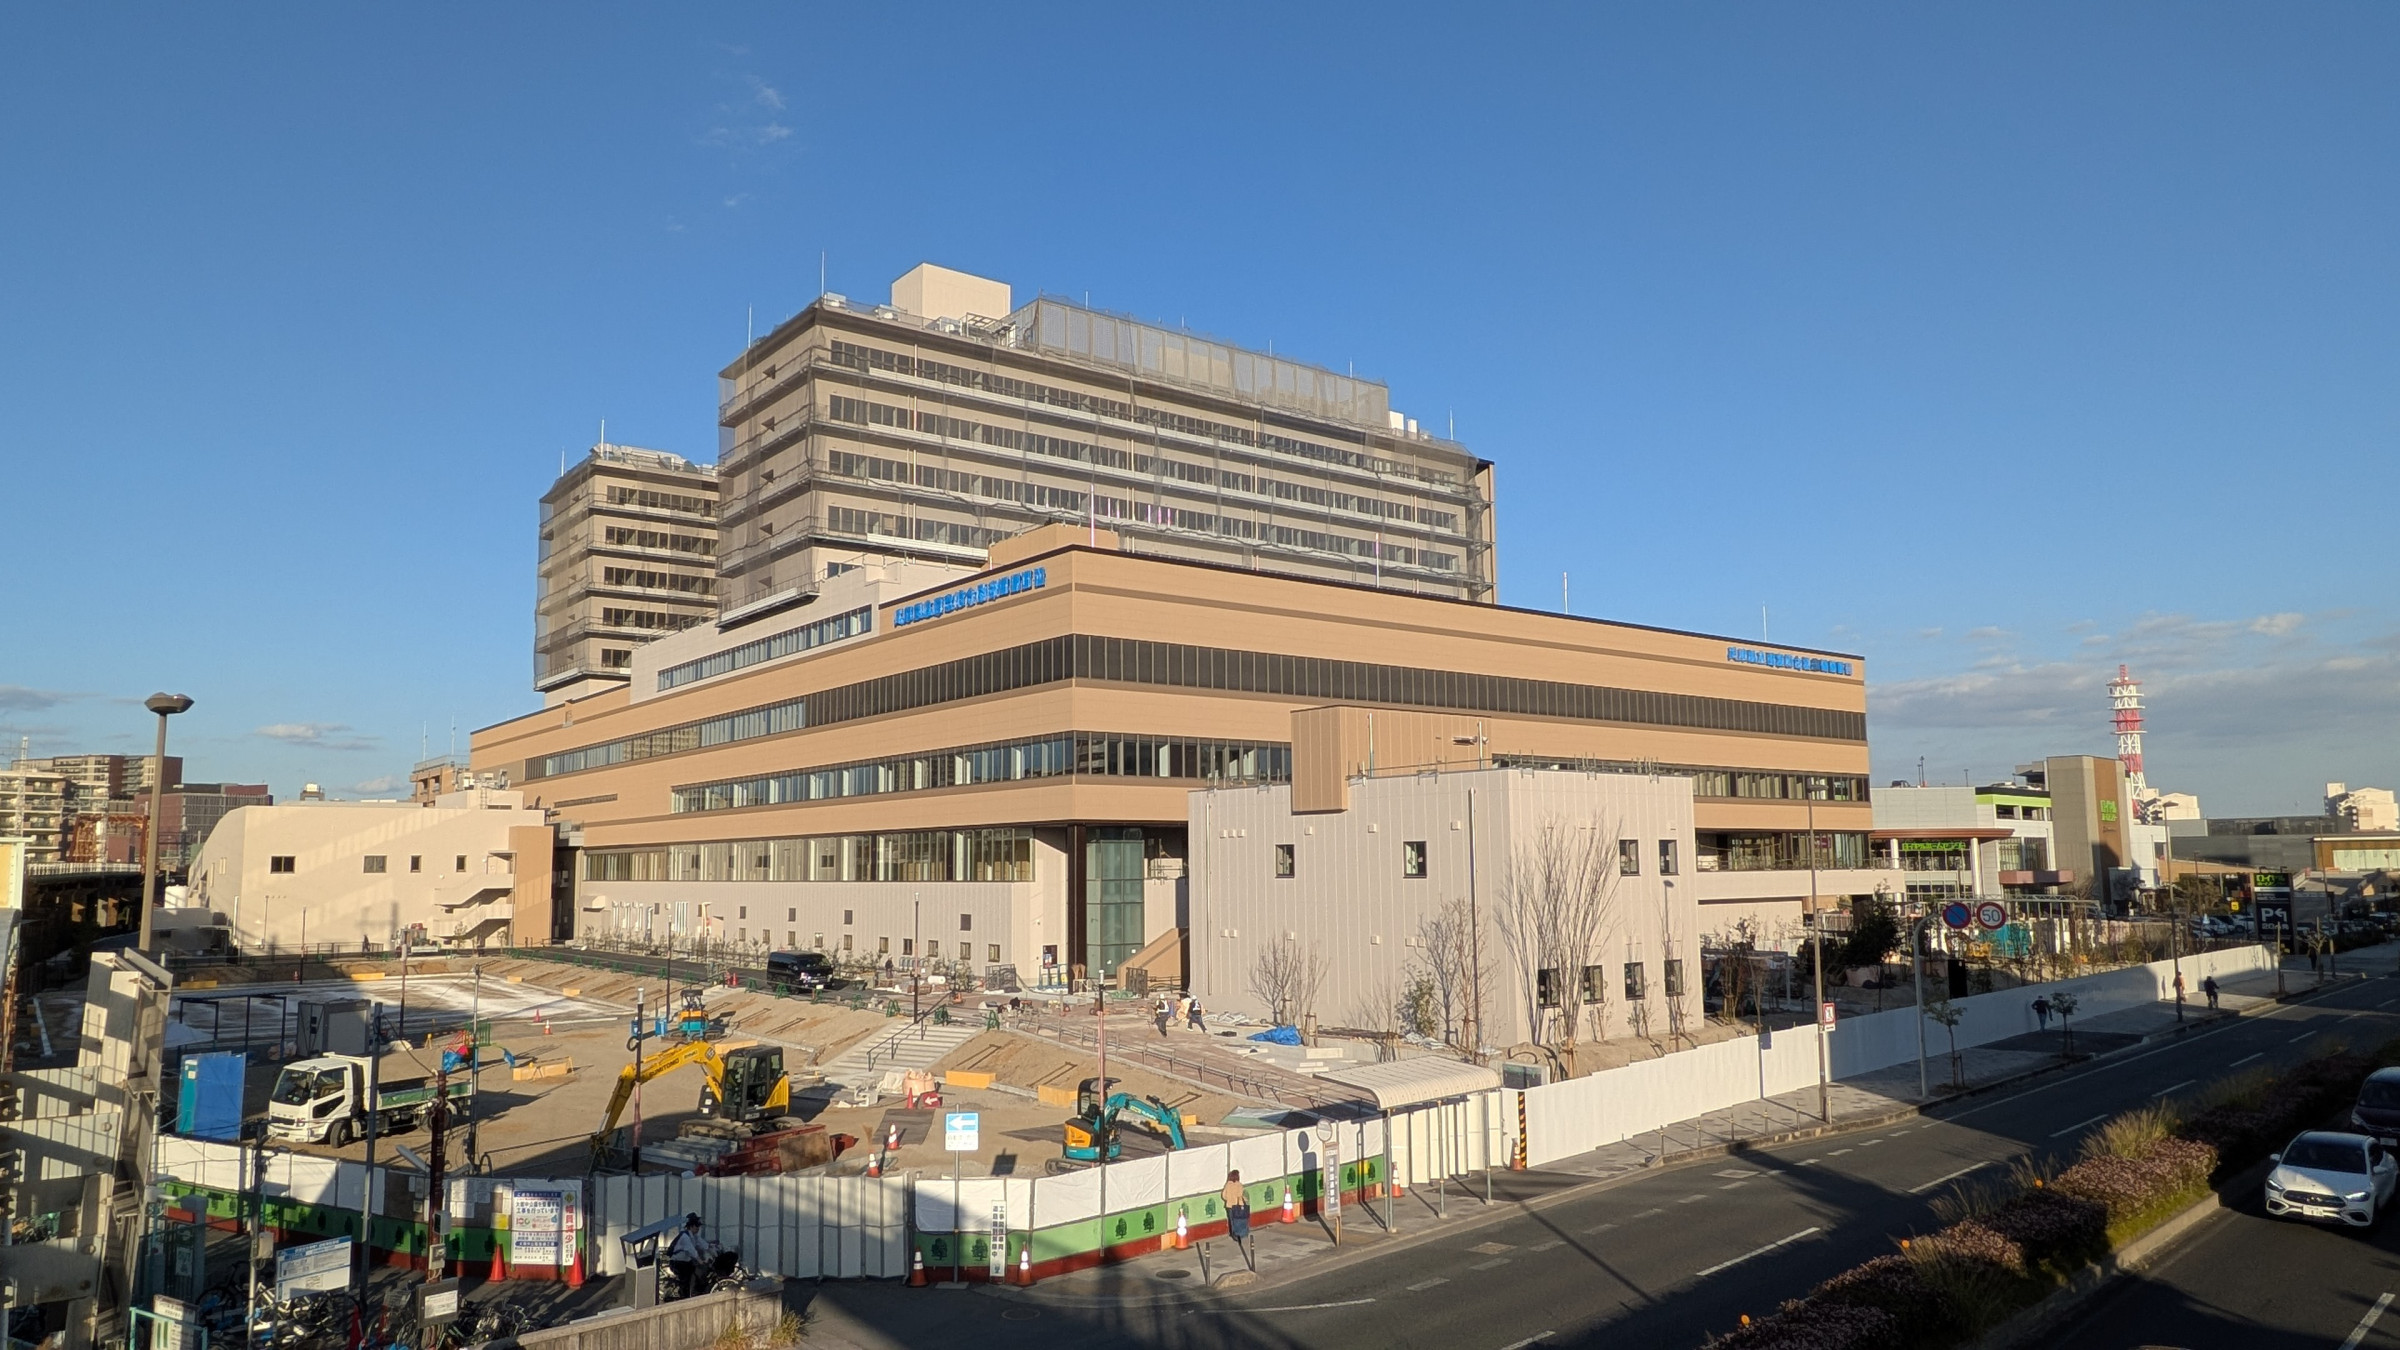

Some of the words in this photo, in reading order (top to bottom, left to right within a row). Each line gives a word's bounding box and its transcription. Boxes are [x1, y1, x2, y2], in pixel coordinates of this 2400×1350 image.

[1982, 909, 2001, 922] 50
[2261, 908, 2274, 922] P
[566, 1206, 574, 1243] 幅員減少
